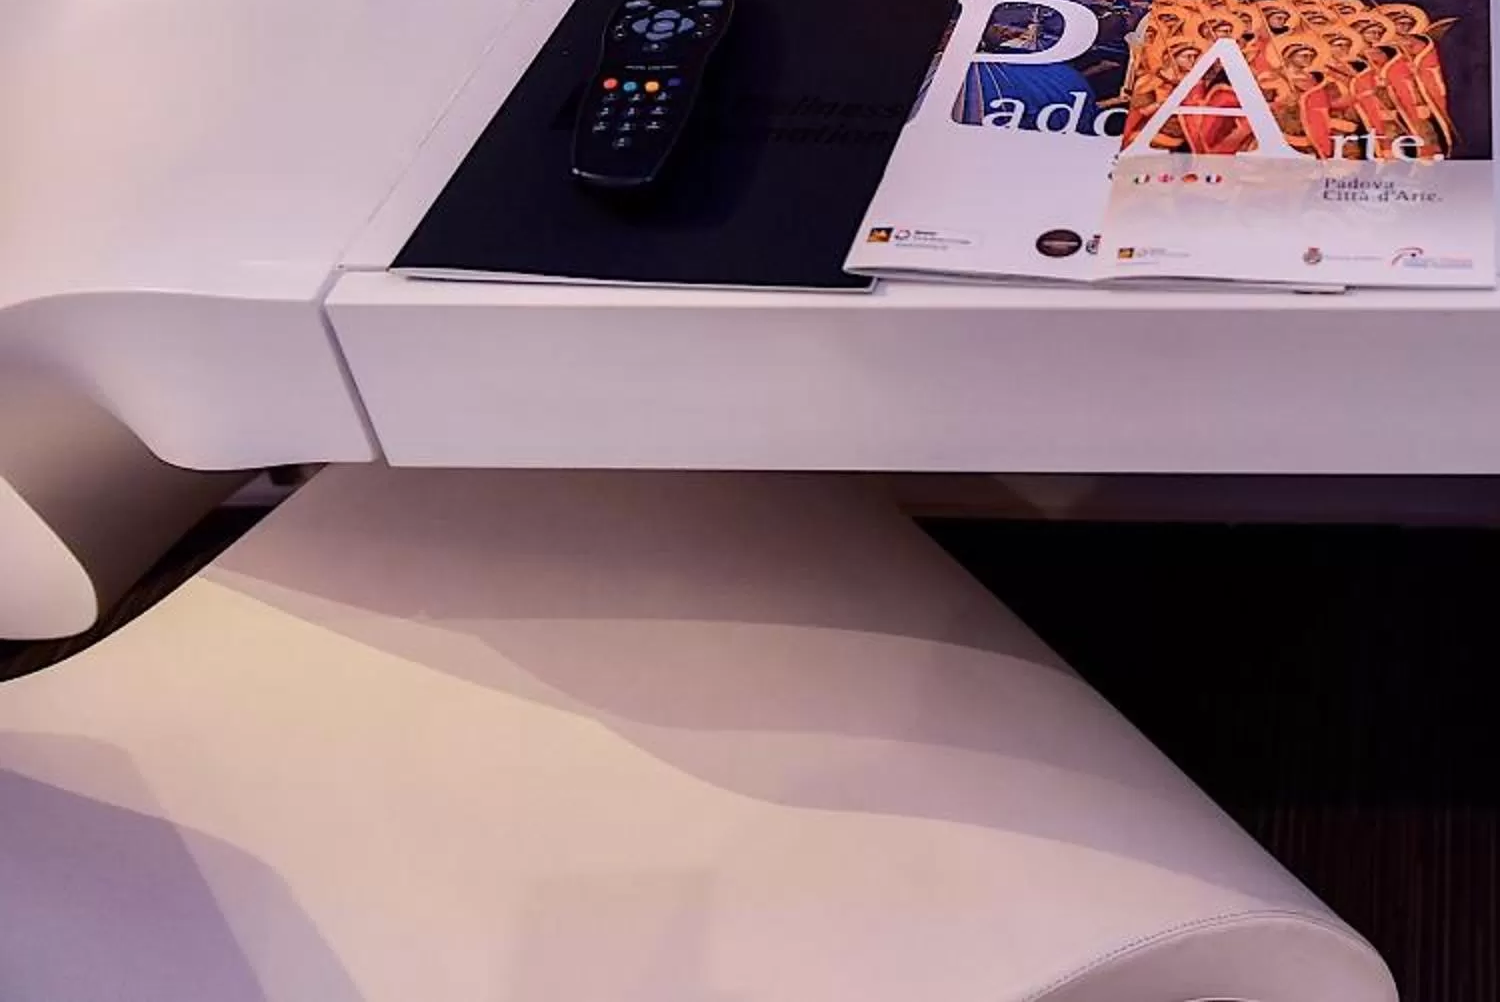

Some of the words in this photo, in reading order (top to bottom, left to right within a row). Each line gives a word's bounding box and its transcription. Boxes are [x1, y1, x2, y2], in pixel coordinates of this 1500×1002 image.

[1117, 37, 1446, 163] Arte.
[1323, 177, 1395, 190] Padova
[1322, 188, 1370, 202] Città
[1377, 188, 1444, 203] d'Arte.
